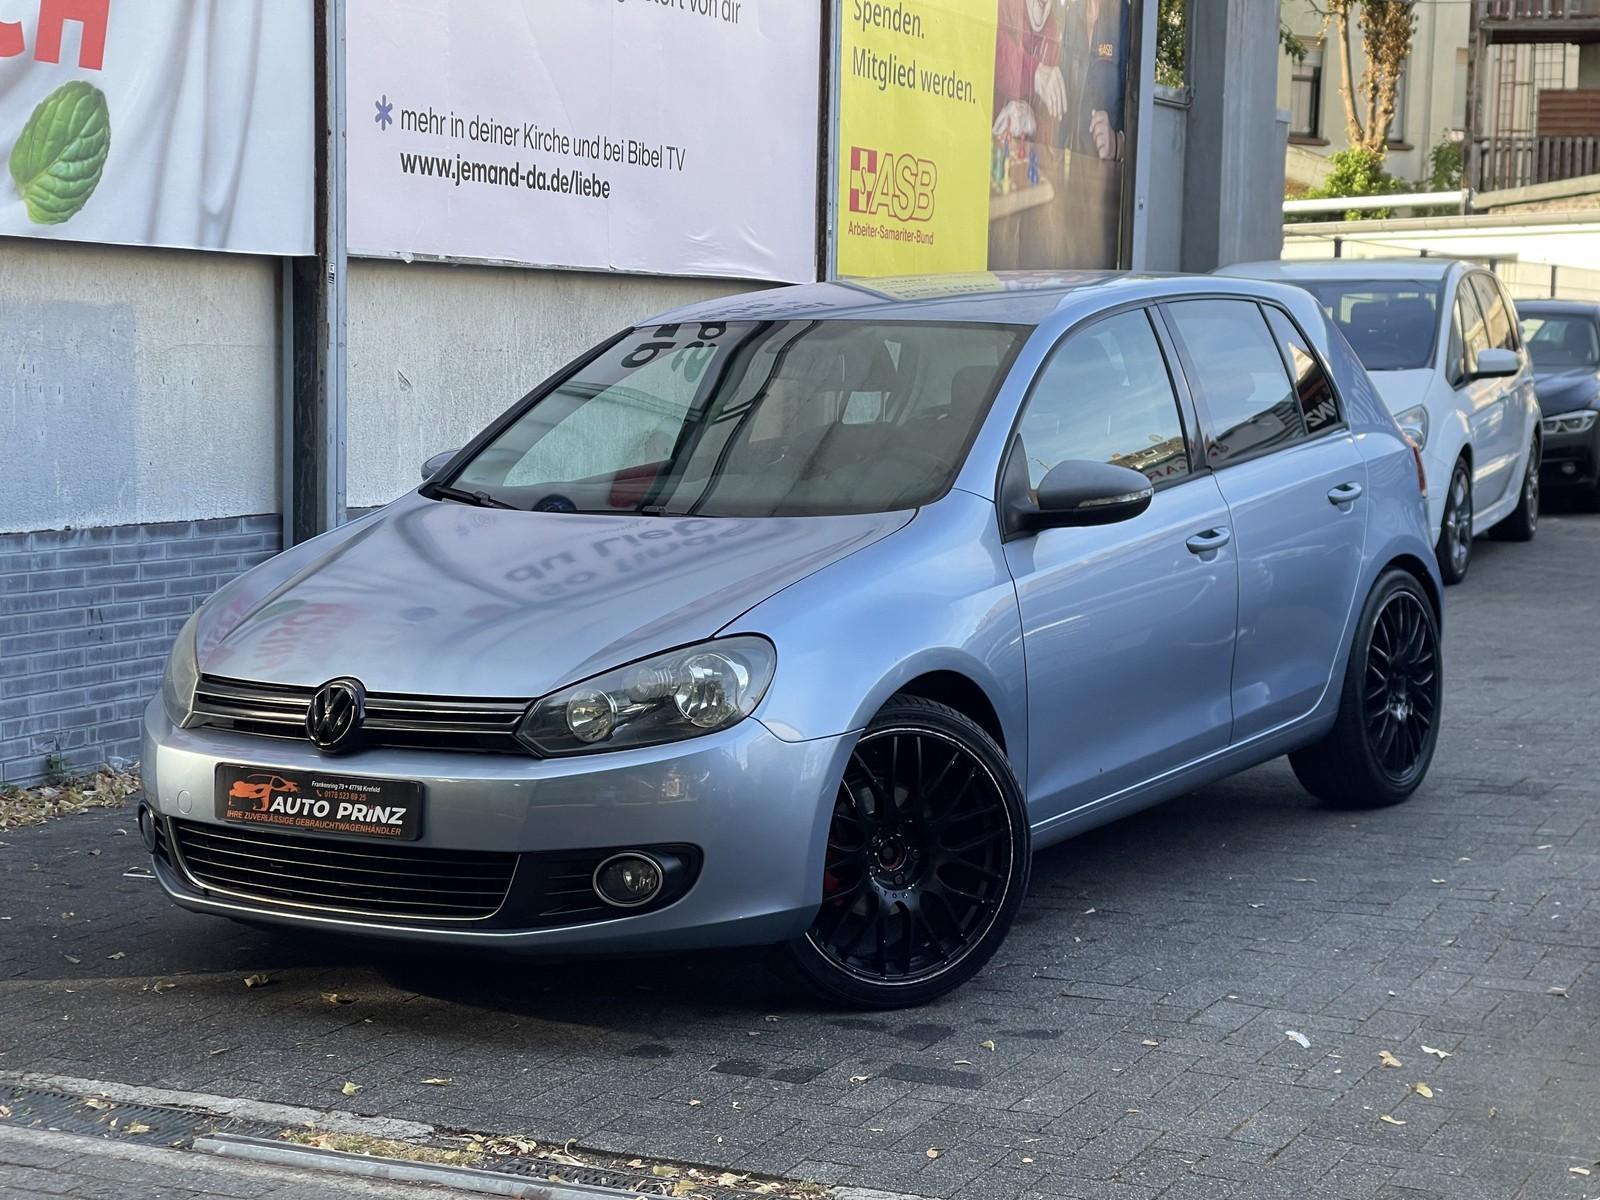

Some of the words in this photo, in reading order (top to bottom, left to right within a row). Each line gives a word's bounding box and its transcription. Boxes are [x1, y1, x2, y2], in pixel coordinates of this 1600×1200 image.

[853, 0, 925, 39] Spenden.
[852, 46, 916, 91] Mitglied
[920, 70, 976, 104] werden.
[401, 107, 447, 134] mehr
[450, 112, 465, 138] in
[469, 115, 520, 147] deiner
[523, 122, 570, 154] Kirche
[573, 135, 600, 160] und
[603, 136, 624, 163] bei
[628, 140, 663, 168] Bibel
[666, 146, 686, 172] TV
[400, 152, 611, 199] www.jemand-da.de/liebe
[868, 153, 938, 222] ASB
[848, 221, 934, 245] Arbeiter-Samariter-Bund
[312, 780, 338, 791] Frankenring
[363, 785, 381, 793] Krefeld
[226, 809, 243, 819] IHRE
[269, 796, 330, 818] AUTO
